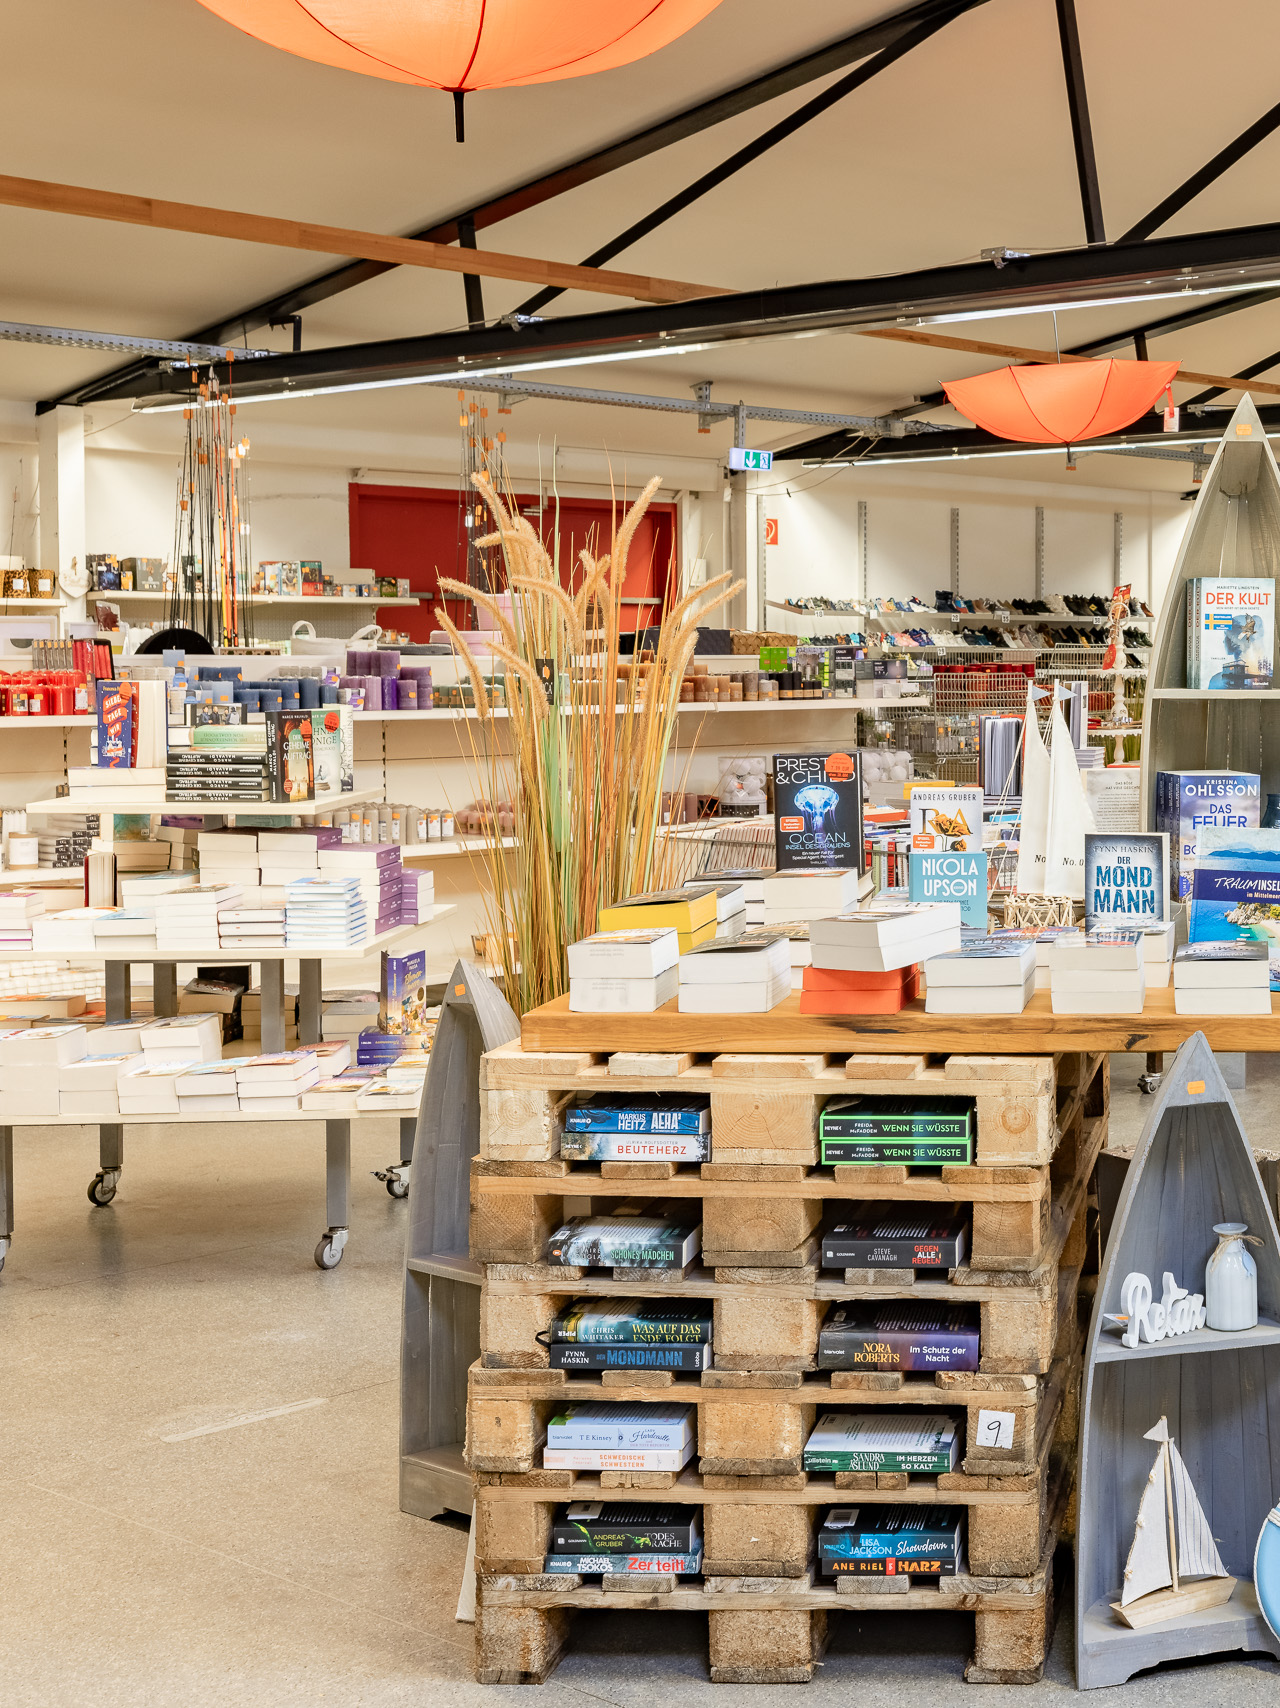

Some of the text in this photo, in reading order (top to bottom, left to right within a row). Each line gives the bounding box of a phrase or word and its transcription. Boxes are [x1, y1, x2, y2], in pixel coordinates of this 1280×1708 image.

[1206, 593, 1271, 605] DER KULT
[105, 695, 122, 708] SIEBE
[108, 708, 121, 722] TAGE
[110, 724, 120, 734] WIR
[283, 741, 310, 750] GEHEIME
[283, 751, 311, 760] AUFTRAG
[1185, 785, 1257, 796] OHLSSON
[1210, 804, 1231, 814] DAS
[789, 832, 846, 844] OCEAN
[1118, 856, 1130, 864] DER
[922, 858, 978, 875] NICOLA
[1096, 866, 1152, 887] MOND
[924, 879, 977, 896] UPSON
[1094, 889, 1154, 913] MANN
[618, 1121, 646, 1130] HEITZ
[882, 1123, 960, 1132] WENN SIE WÜSSTE
[618, 1146, 686, 1154] BEUTEHERZ
[926, 1148, 961, 1156] WÜSSTE
[642, 1249, 674, 1260] MÄDCHEN
[632, 1324, 700, 1334] WAS AUF DAS
[634, 1334, 662, 1342] ENDE
[863, 1342, 892, 1353] NORA
[910, 1346, 966, 1354] Im Schutz der
[606, 1350, 683, 1366] MONDMANN
[854, 1352, 900, 1363] ROBERTS
[926, 1354, 950, 1362] Nacht
[592, 1434, 612, 1442] Kinsey
[852, 1452, 884, 1462] SANDRA
[645, 1532, 674, 1540] TODES
[650, 1540, 682, 1548] RACHE
[861, 1538, 880, 1546] LISA
[896, 1538, 948, 1556] Showdown
[850, 1546, 892, 1554] JACKSON
[577, 1564, 613, 1572] TSOKOS
[628, 1557, 685, 1572] Zer teilt
[832, 1562, 884, 1570] ANE RIEL
[898, 1560, 940, 1572] HARZ
